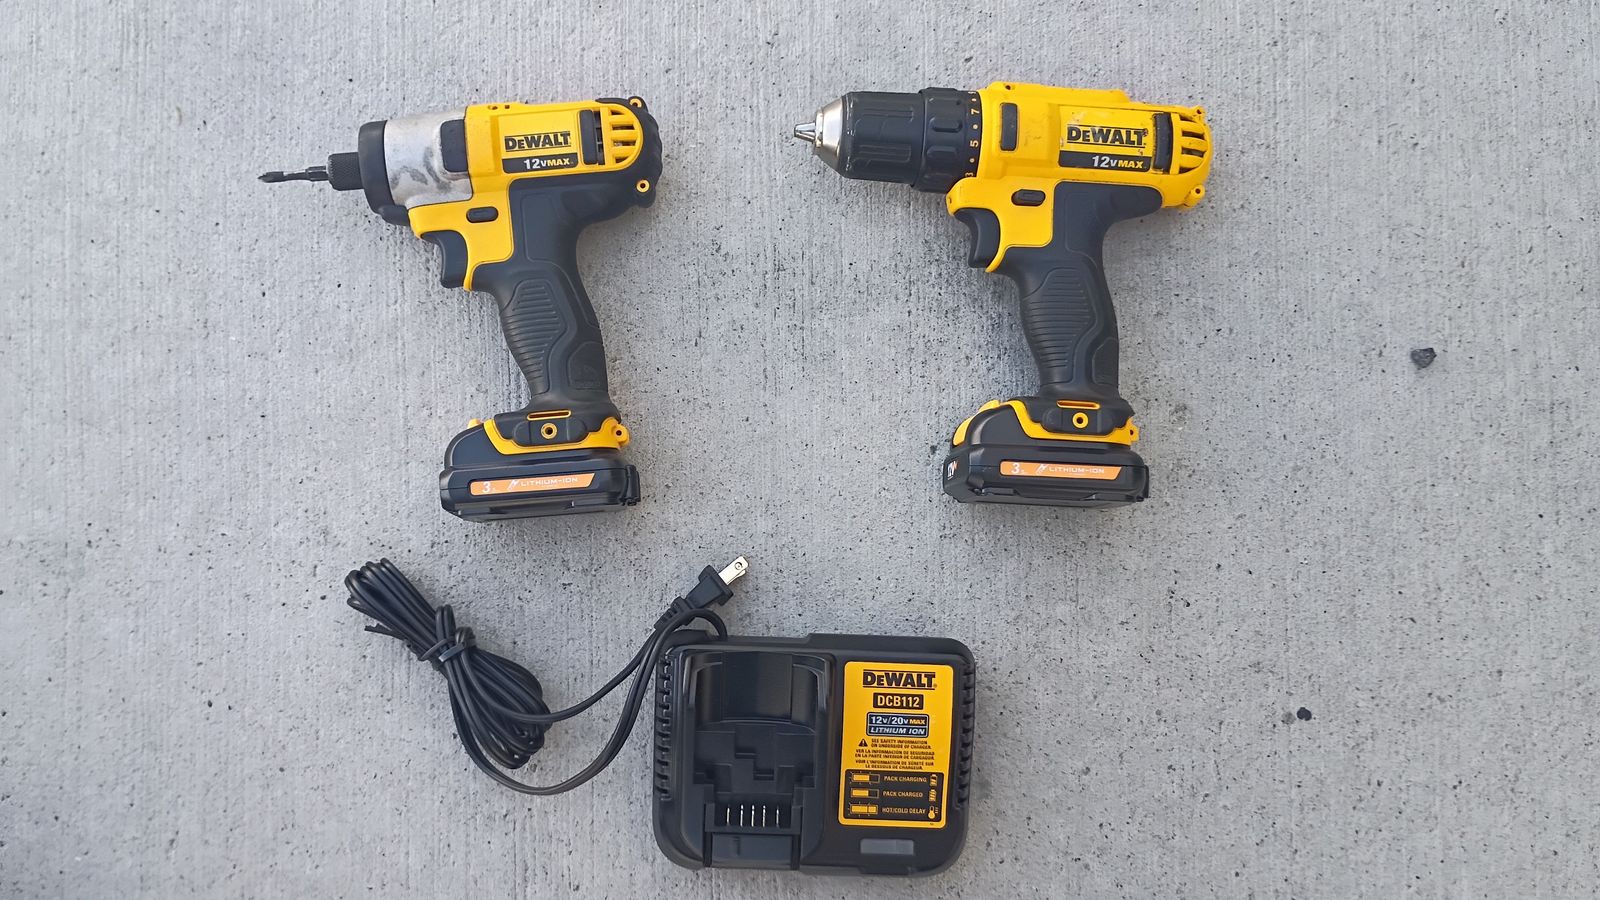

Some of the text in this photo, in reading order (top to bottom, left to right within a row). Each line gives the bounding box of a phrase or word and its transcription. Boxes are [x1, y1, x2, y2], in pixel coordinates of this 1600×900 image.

[970, 140, 979, 148] 5
[1011, 462, 1105, 474] 3 LITHIUM-ION
[482, 477, 578, 493] 3 LITHIUM-ION
[877, 695, 920, 708] DCB112
